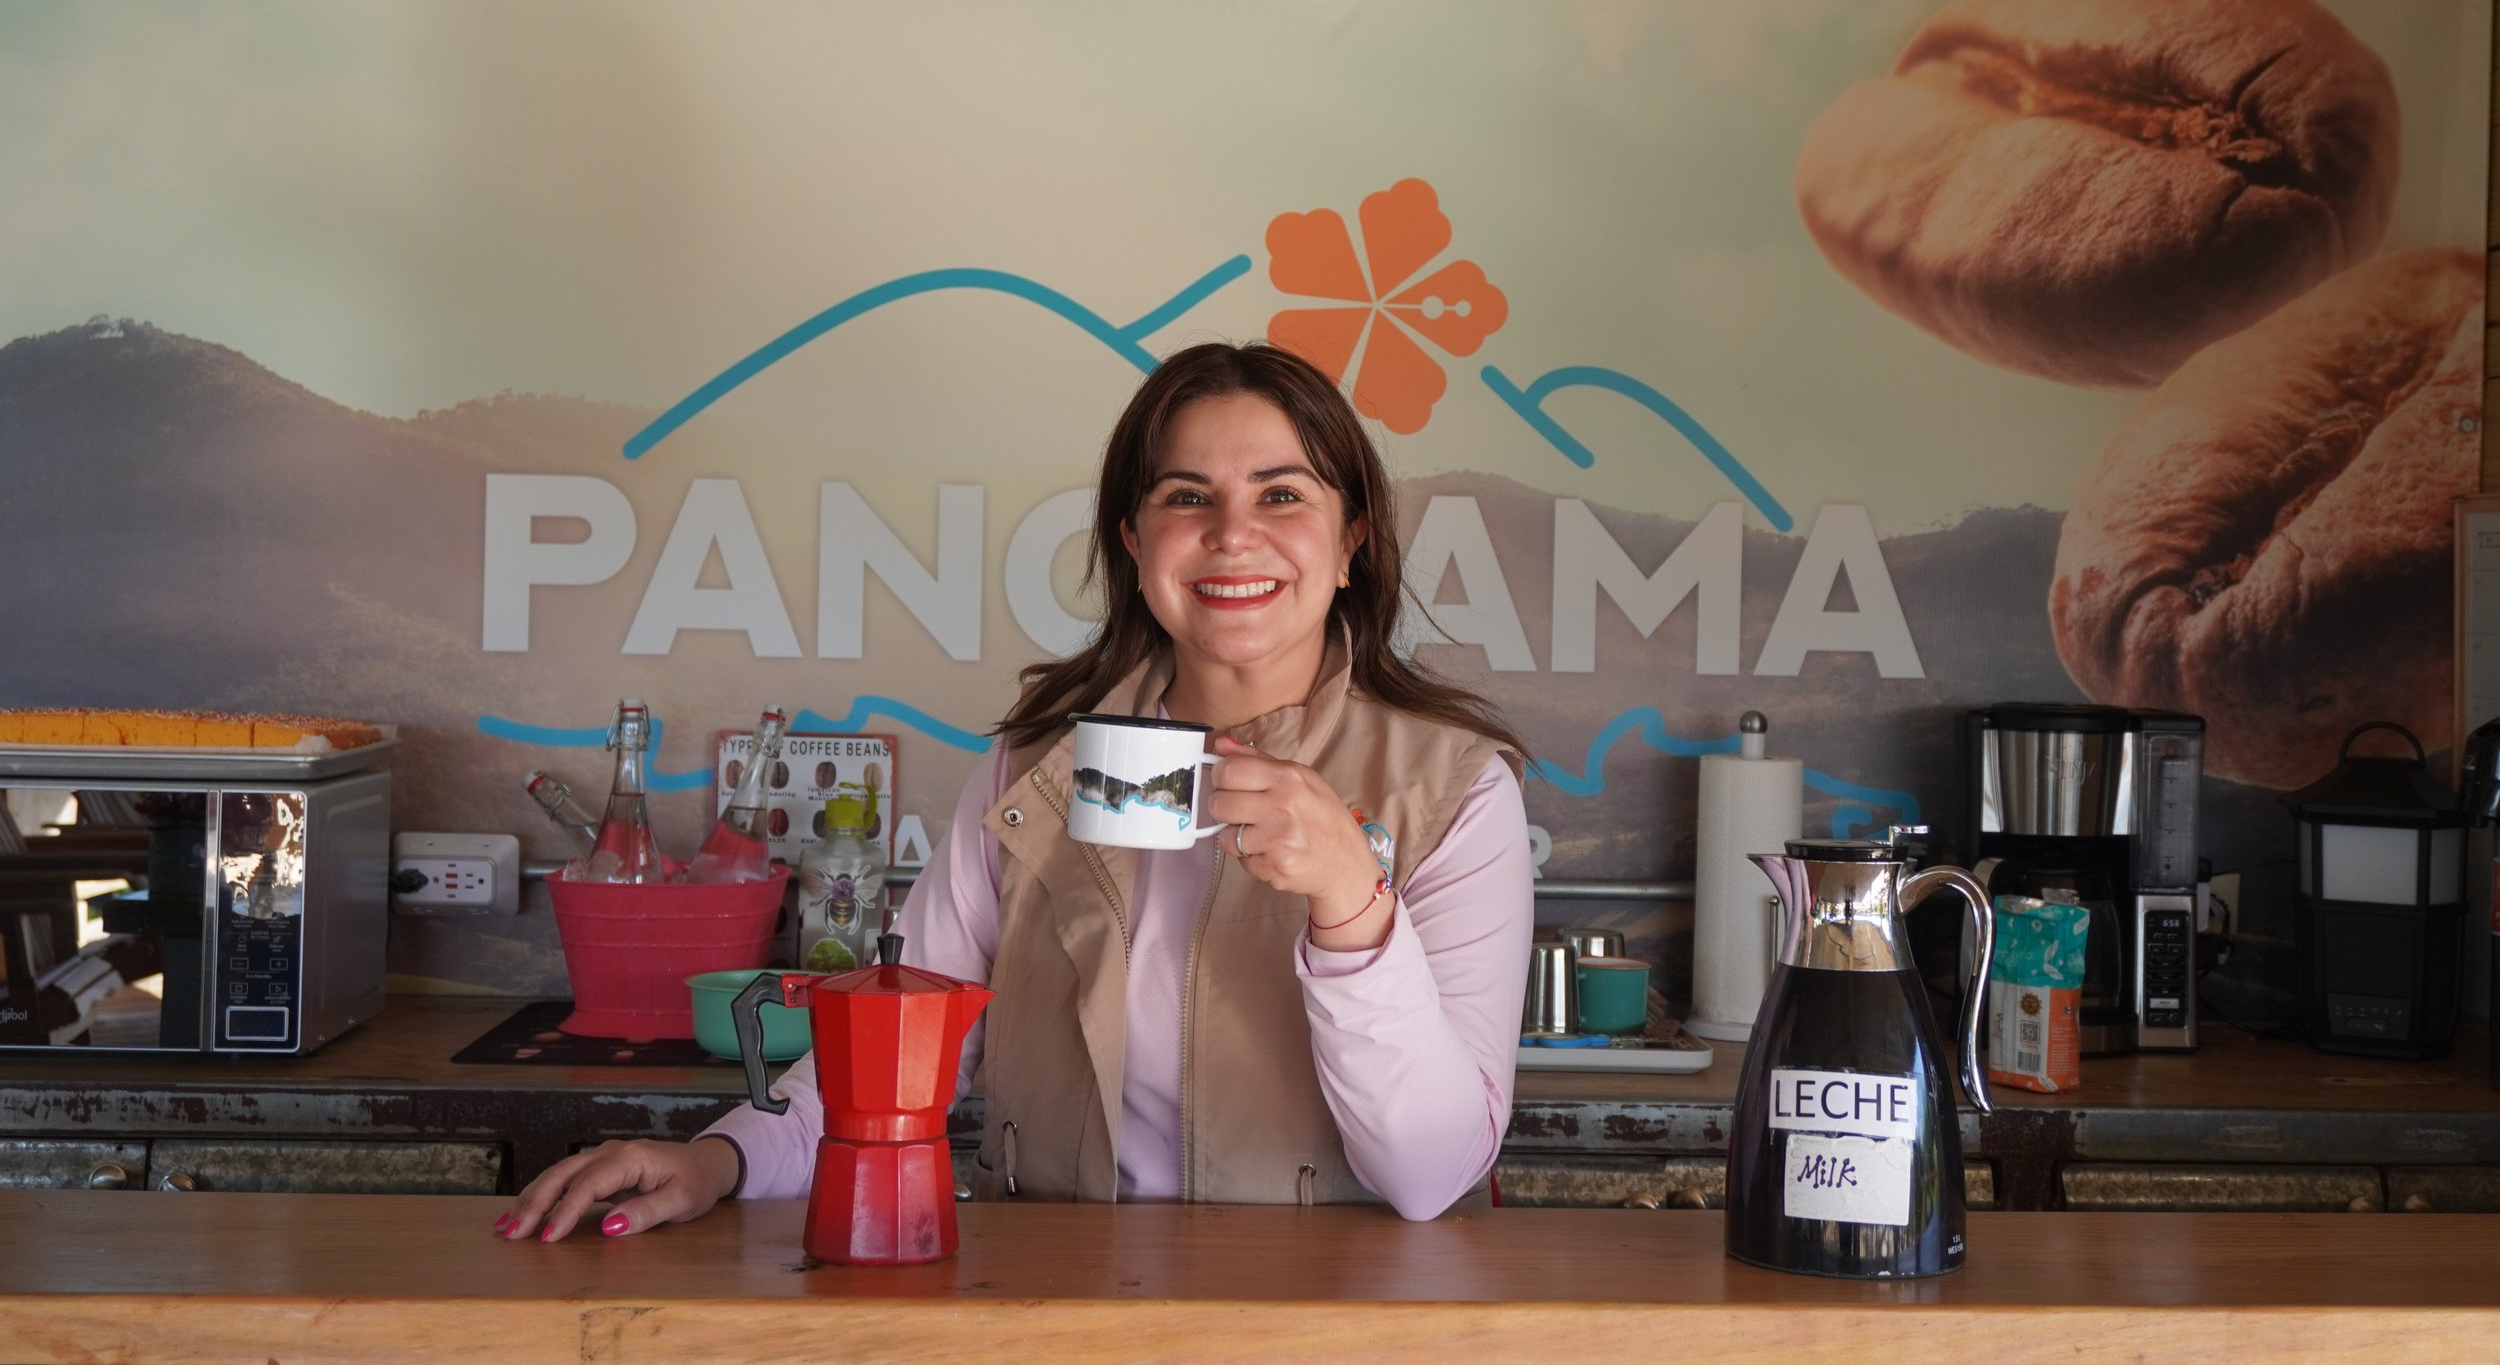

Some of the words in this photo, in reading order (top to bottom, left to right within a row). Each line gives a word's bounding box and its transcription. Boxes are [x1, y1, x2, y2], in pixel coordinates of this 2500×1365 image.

[482, 473, 1926, 679] PANOAMA
[789, 740, 841, 756] COFFEE
[846, 742, 890, 758] BEANS
[1775, 1080, 1909, 1122] LECHE
[1797, 1154, 1857, 1189] Milk
